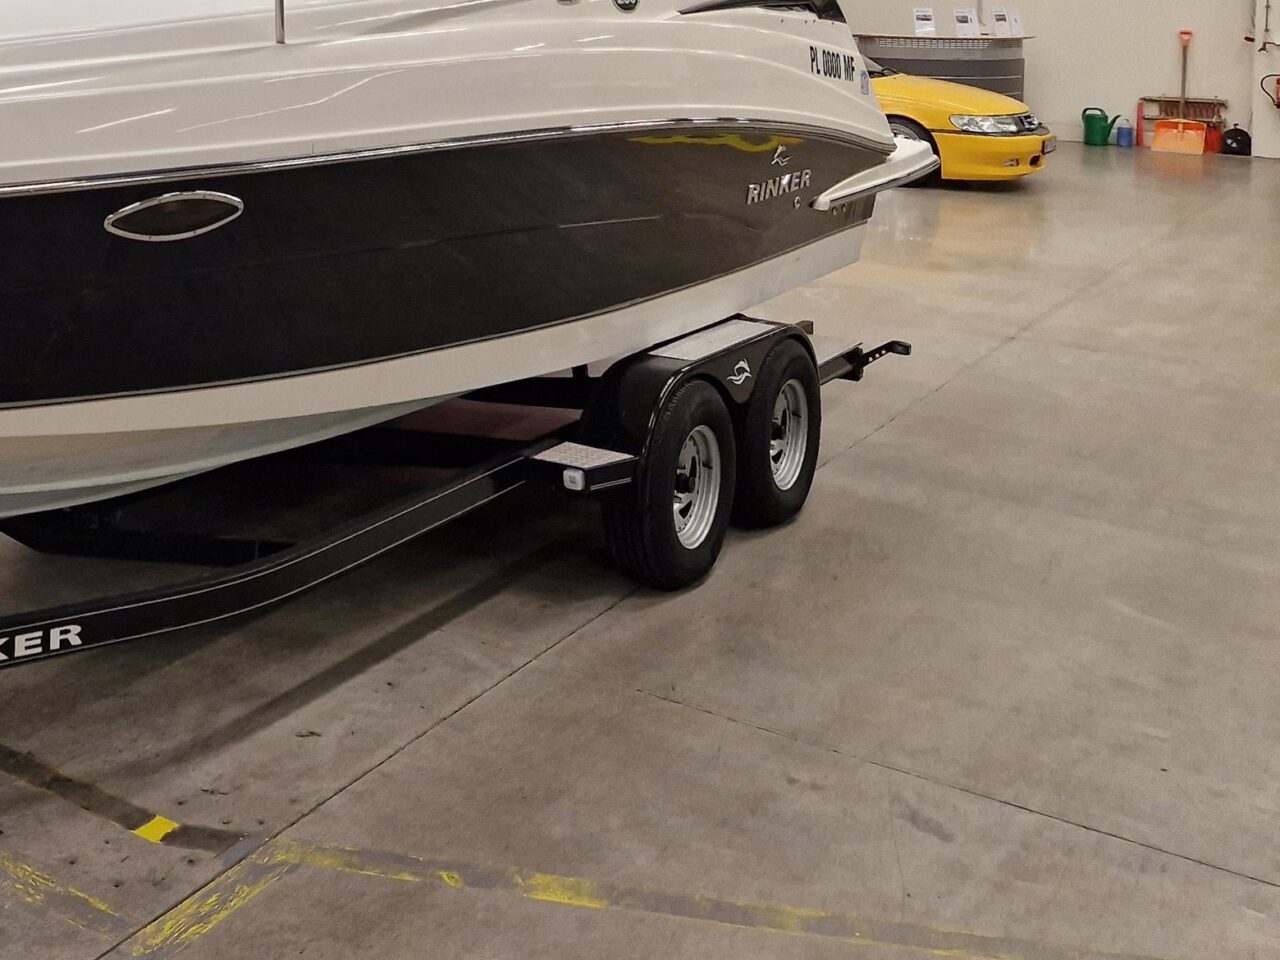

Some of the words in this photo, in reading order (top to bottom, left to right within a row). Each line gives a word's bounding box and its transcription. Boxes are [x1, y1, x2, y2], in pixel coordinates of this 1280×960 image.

[809, 45, 820, 75] PL
[843, 54, 855, 82] MF
[746, 169, 812, 205] RINKER
